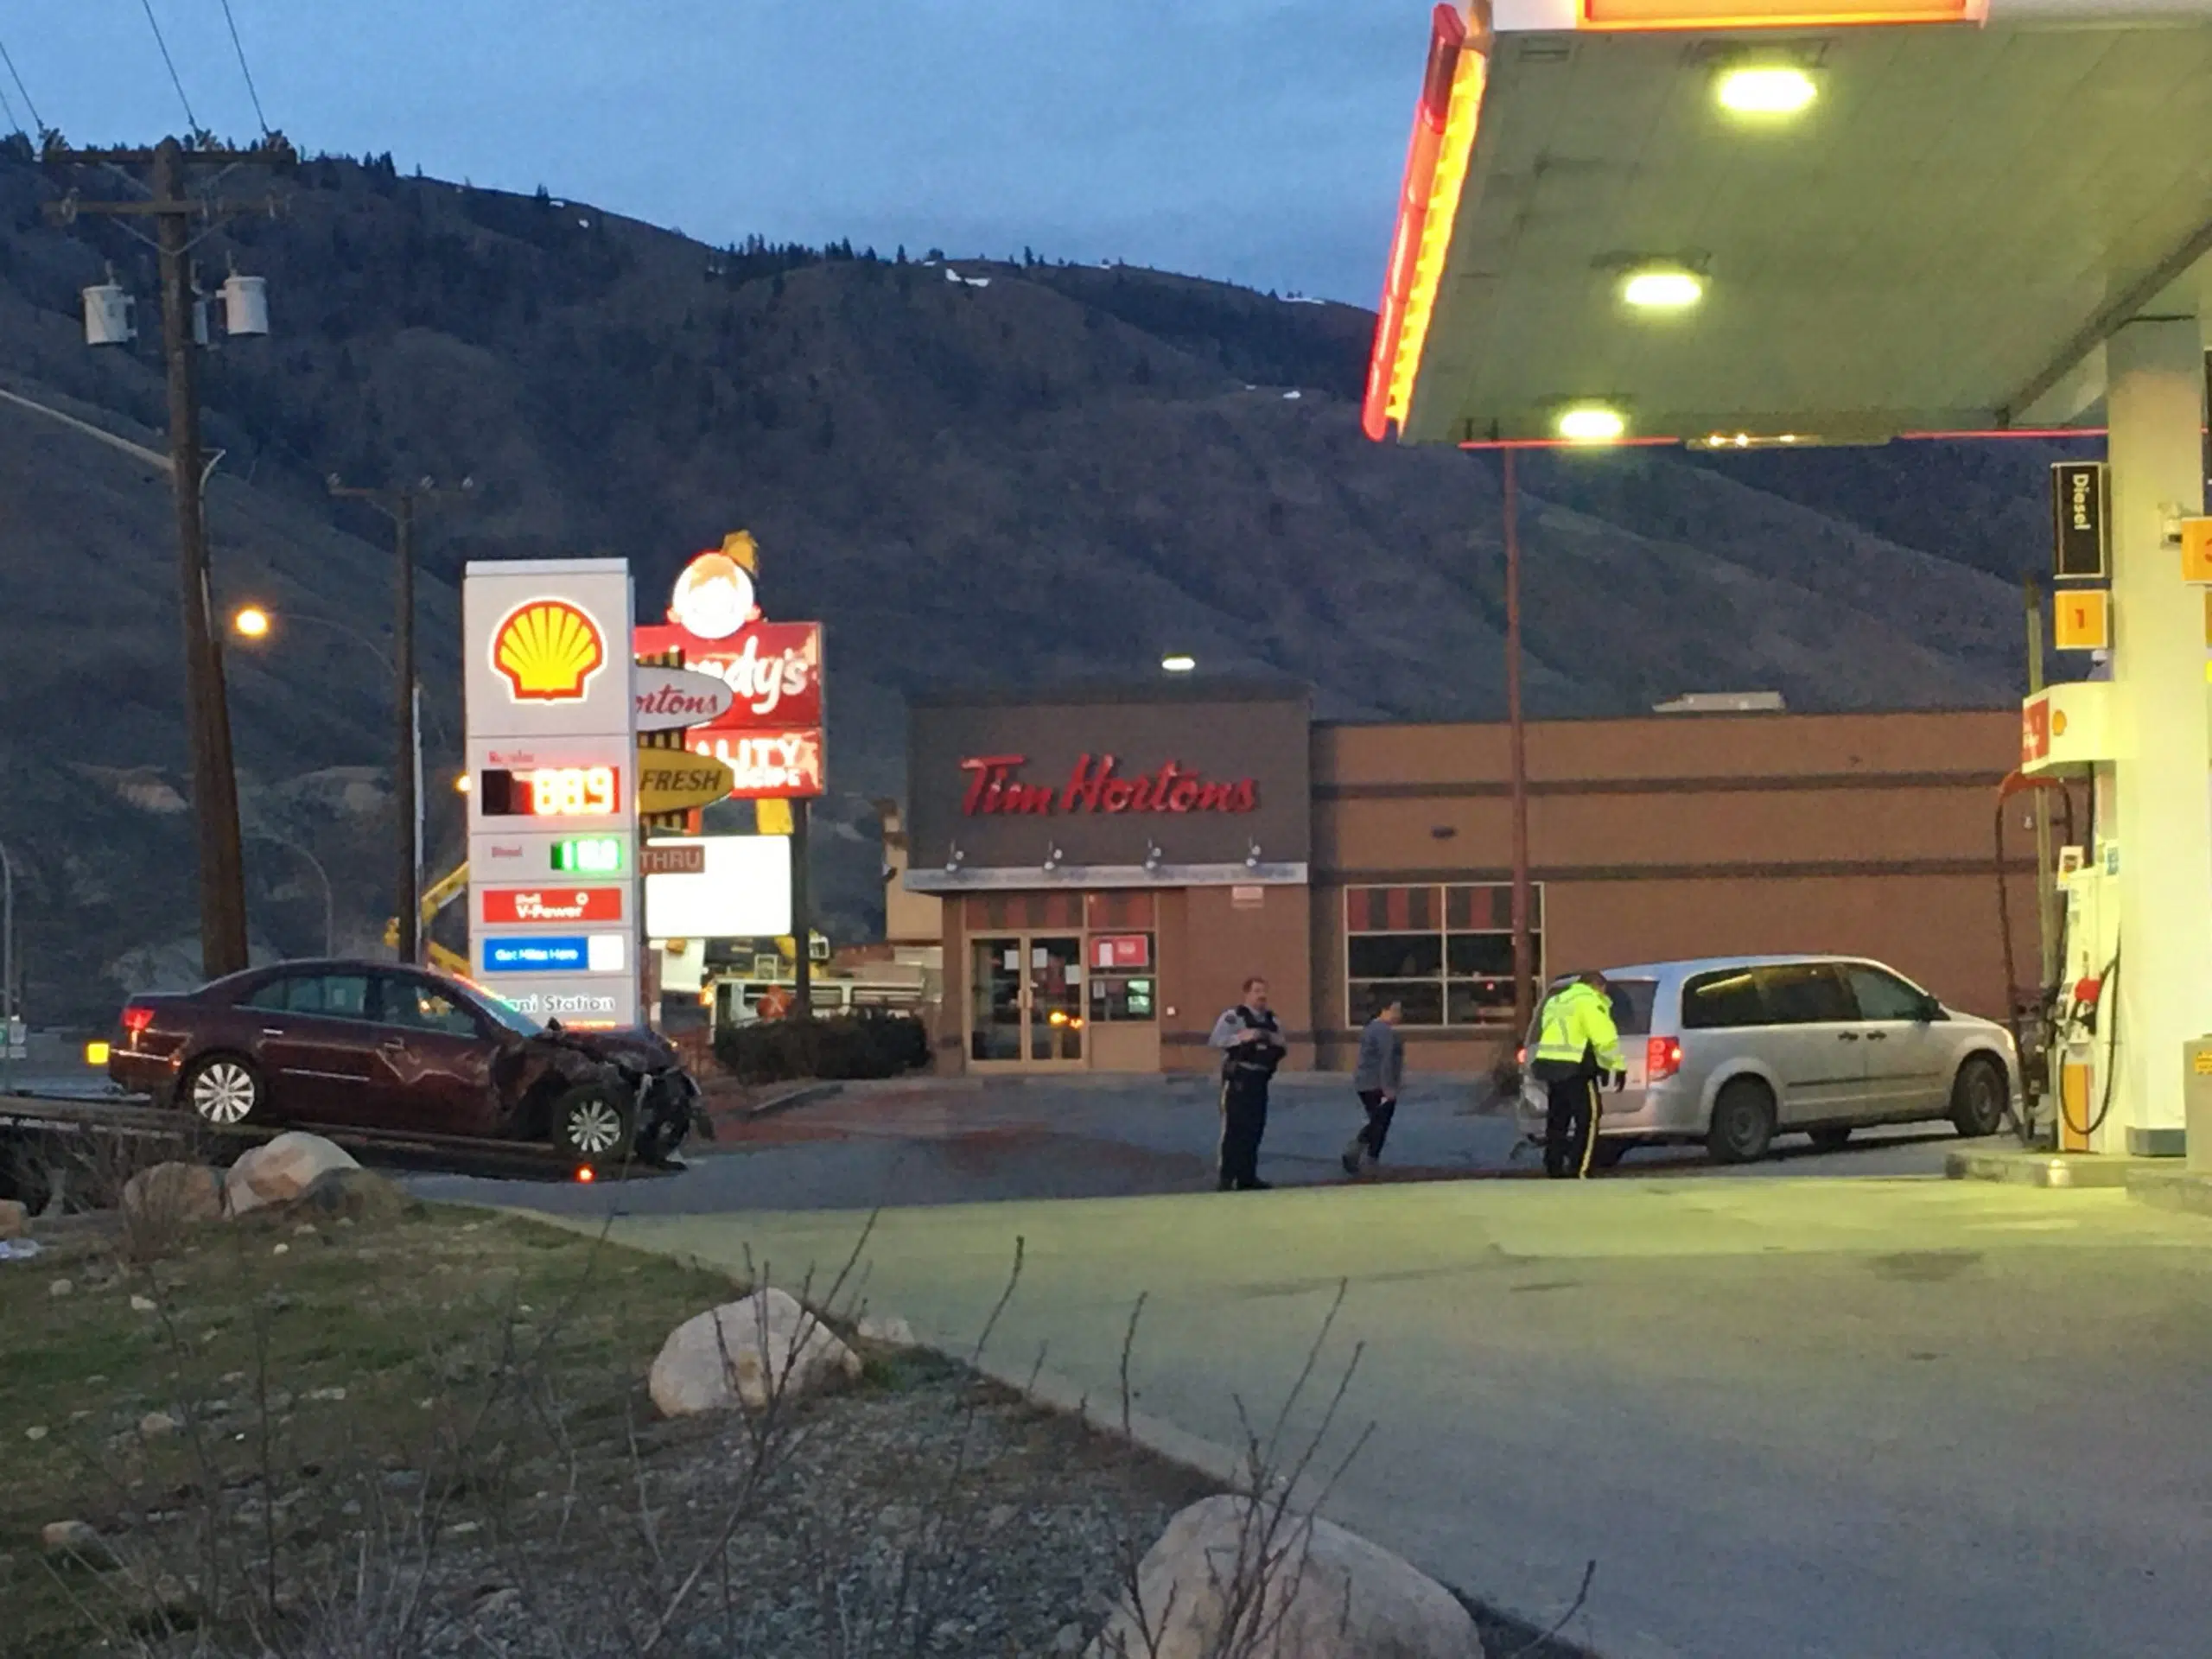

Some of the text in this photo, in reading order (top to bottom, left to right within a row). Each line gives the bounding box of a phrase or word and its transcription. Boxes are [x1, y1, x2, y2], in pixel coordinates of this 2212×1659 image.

[2073, 474, 2092, 531] Diesel
[636, 683, 718, 715] ortons
[639, 768, 721, 791] FRESH
[960, 753, 1257, 817] Tim Hortons
[639, 849, 701, 870] THRU
[544, 994, 615, 1012] Station
